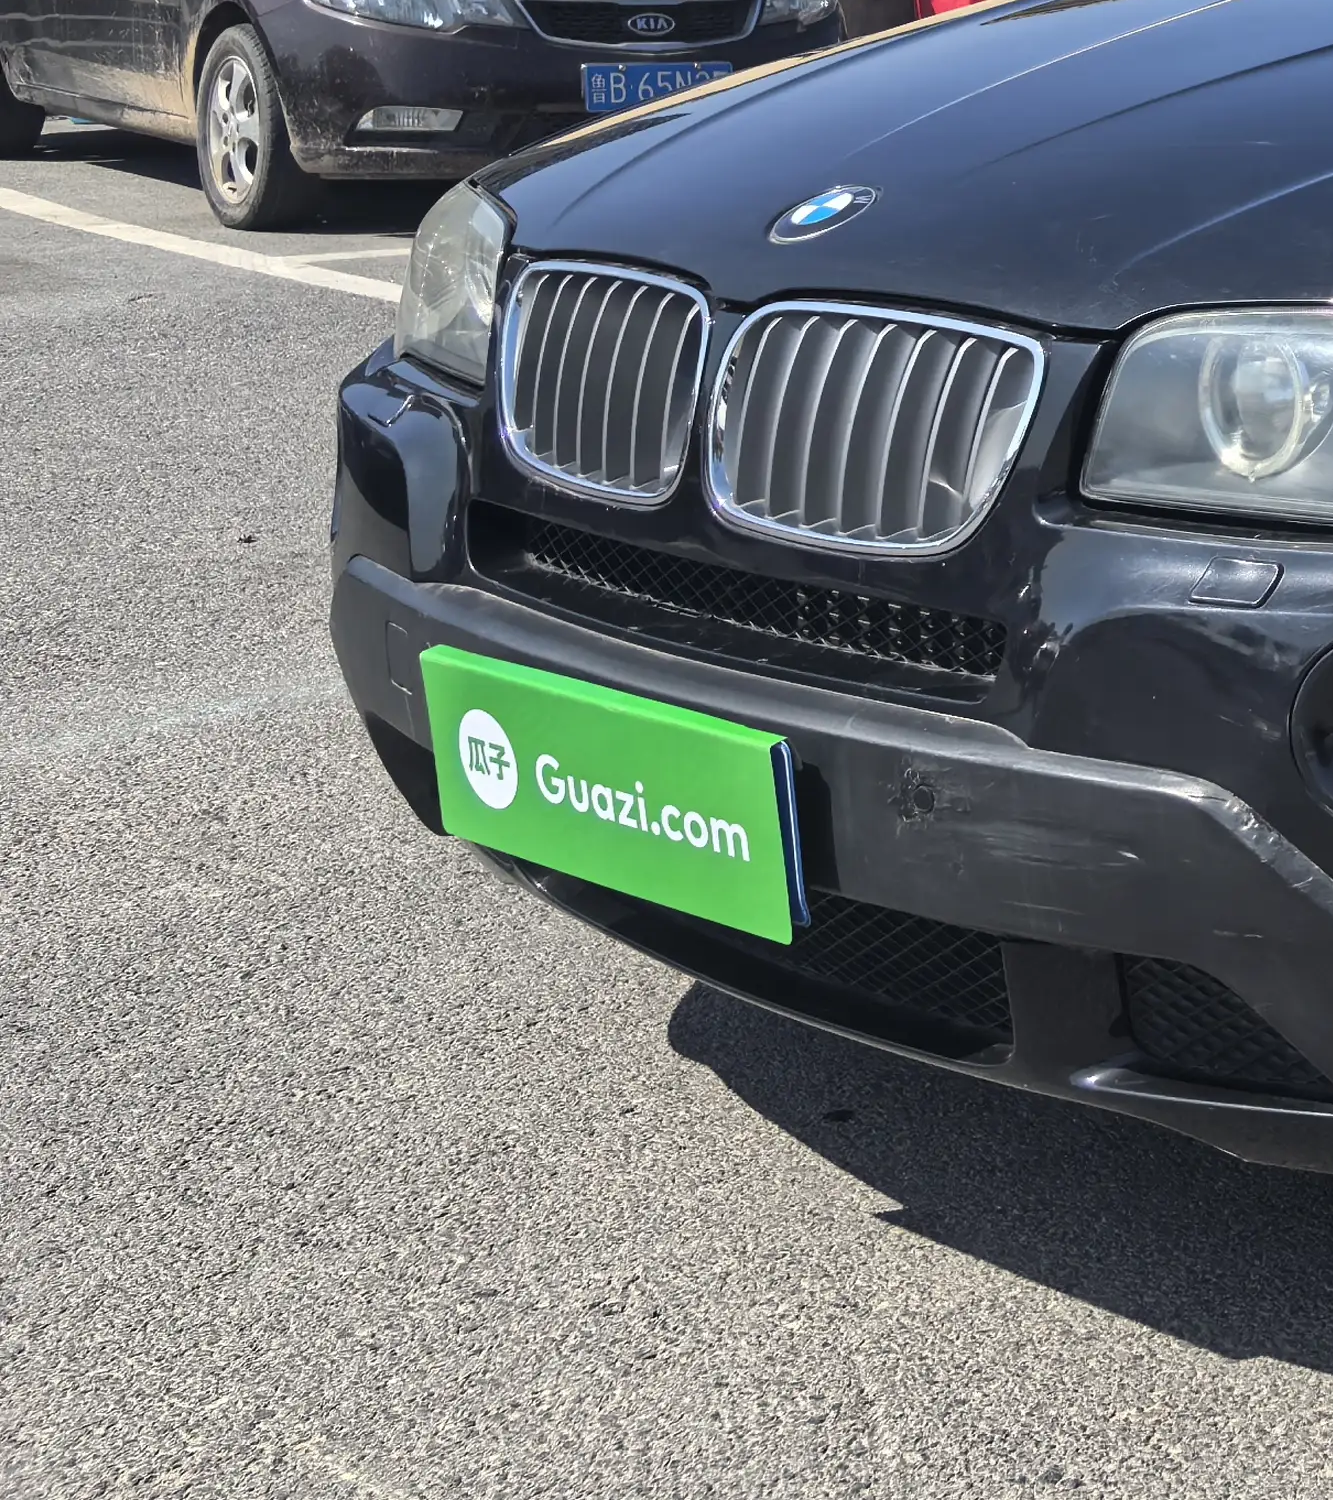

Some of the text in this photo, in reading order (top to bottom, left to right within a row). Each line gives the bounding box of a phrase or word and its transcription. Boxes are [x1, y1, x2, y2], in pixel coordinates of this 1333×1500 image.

[636, 17, 668, 29] KIA
[467, 735, 511, 781] 瓜子
[534, 753, 751, 862] Guazi.com
